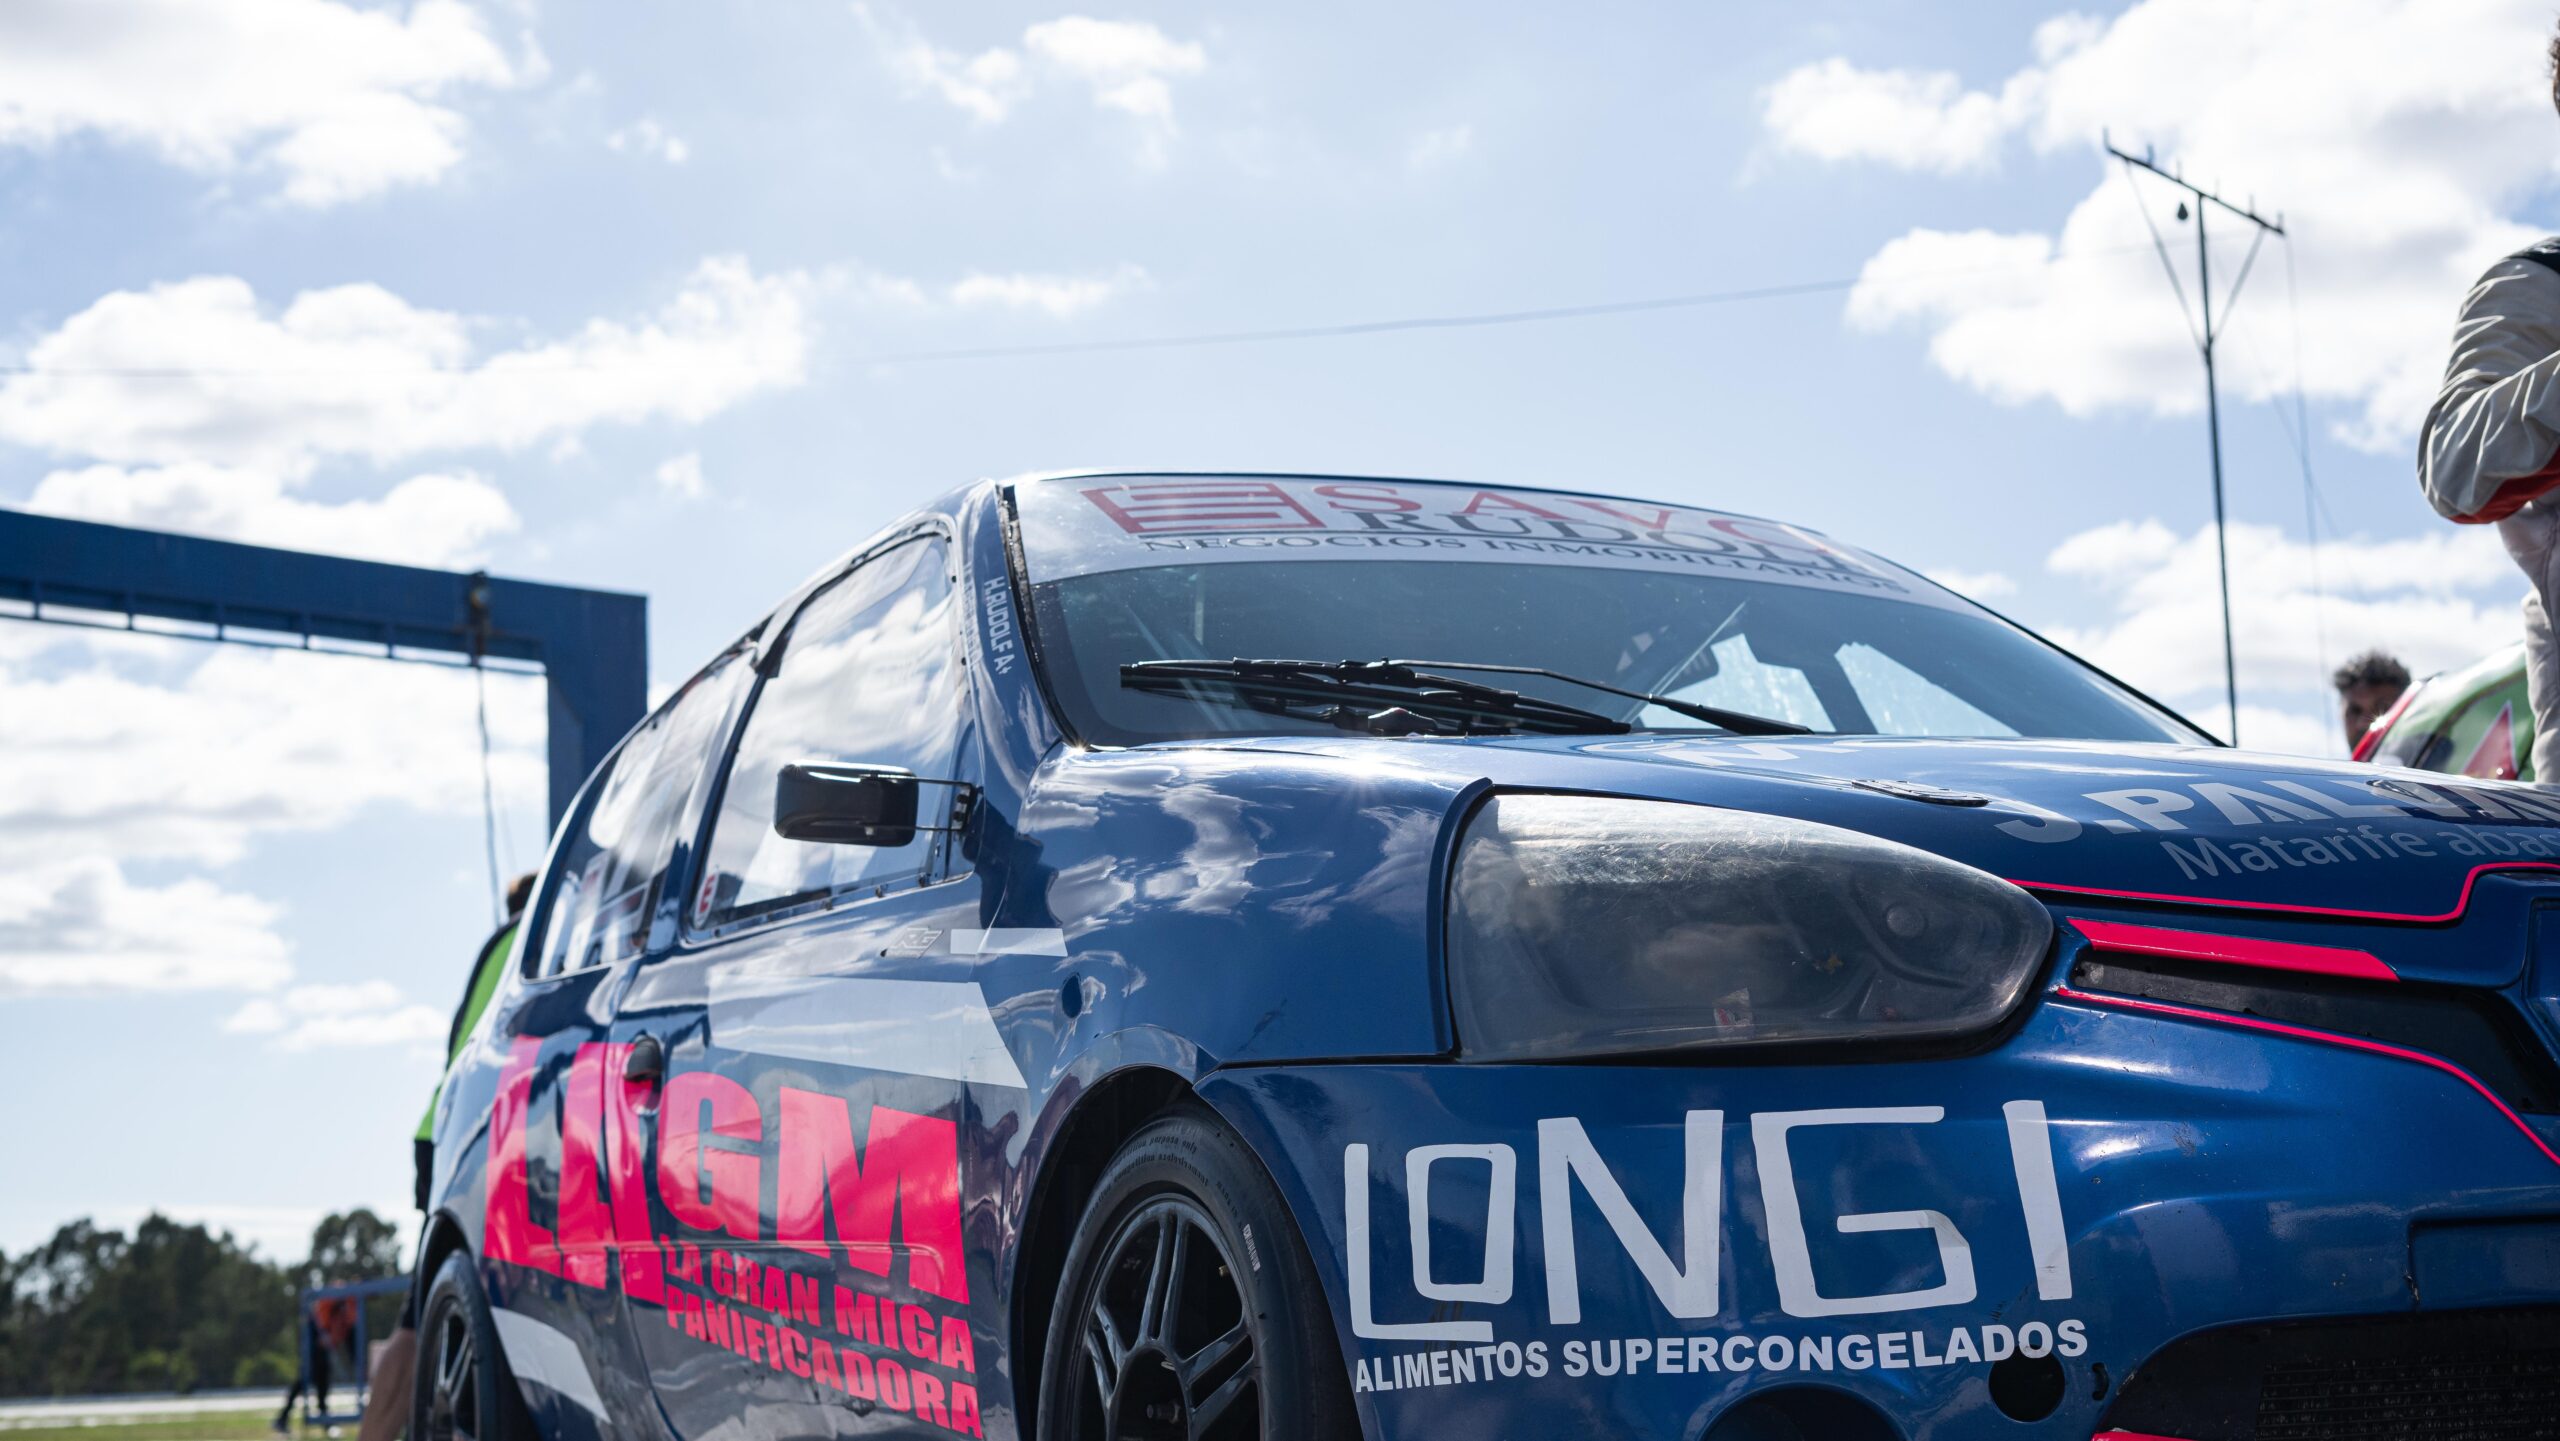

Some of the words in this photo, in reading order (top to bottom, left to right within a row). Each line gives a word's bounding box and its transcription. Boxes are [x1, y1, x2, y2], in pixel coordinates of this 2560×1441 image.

[1141, 535, 1467, 552] NEGOCIOS
[1482, 539, 1912, 595] INMOBILIARIOS
[983, 575, 1014, 653] H.RUDOLF
[2160, 824, 2439, 880] Matarife
[1343, 1100, 2073, 1342] LONGI
[659, 1233, 703, 1286] LA
[710, 1247, 821, 1328] GRAN
[833, 1283, 976, 1374] MIGA
[665, 1283, 983, 1440] PANIFICADORA
[1354, 1341, 1550, 1393] ALIMENTOS
[1562, 1318, 2089, 1377] SUPERCONGELADOS
